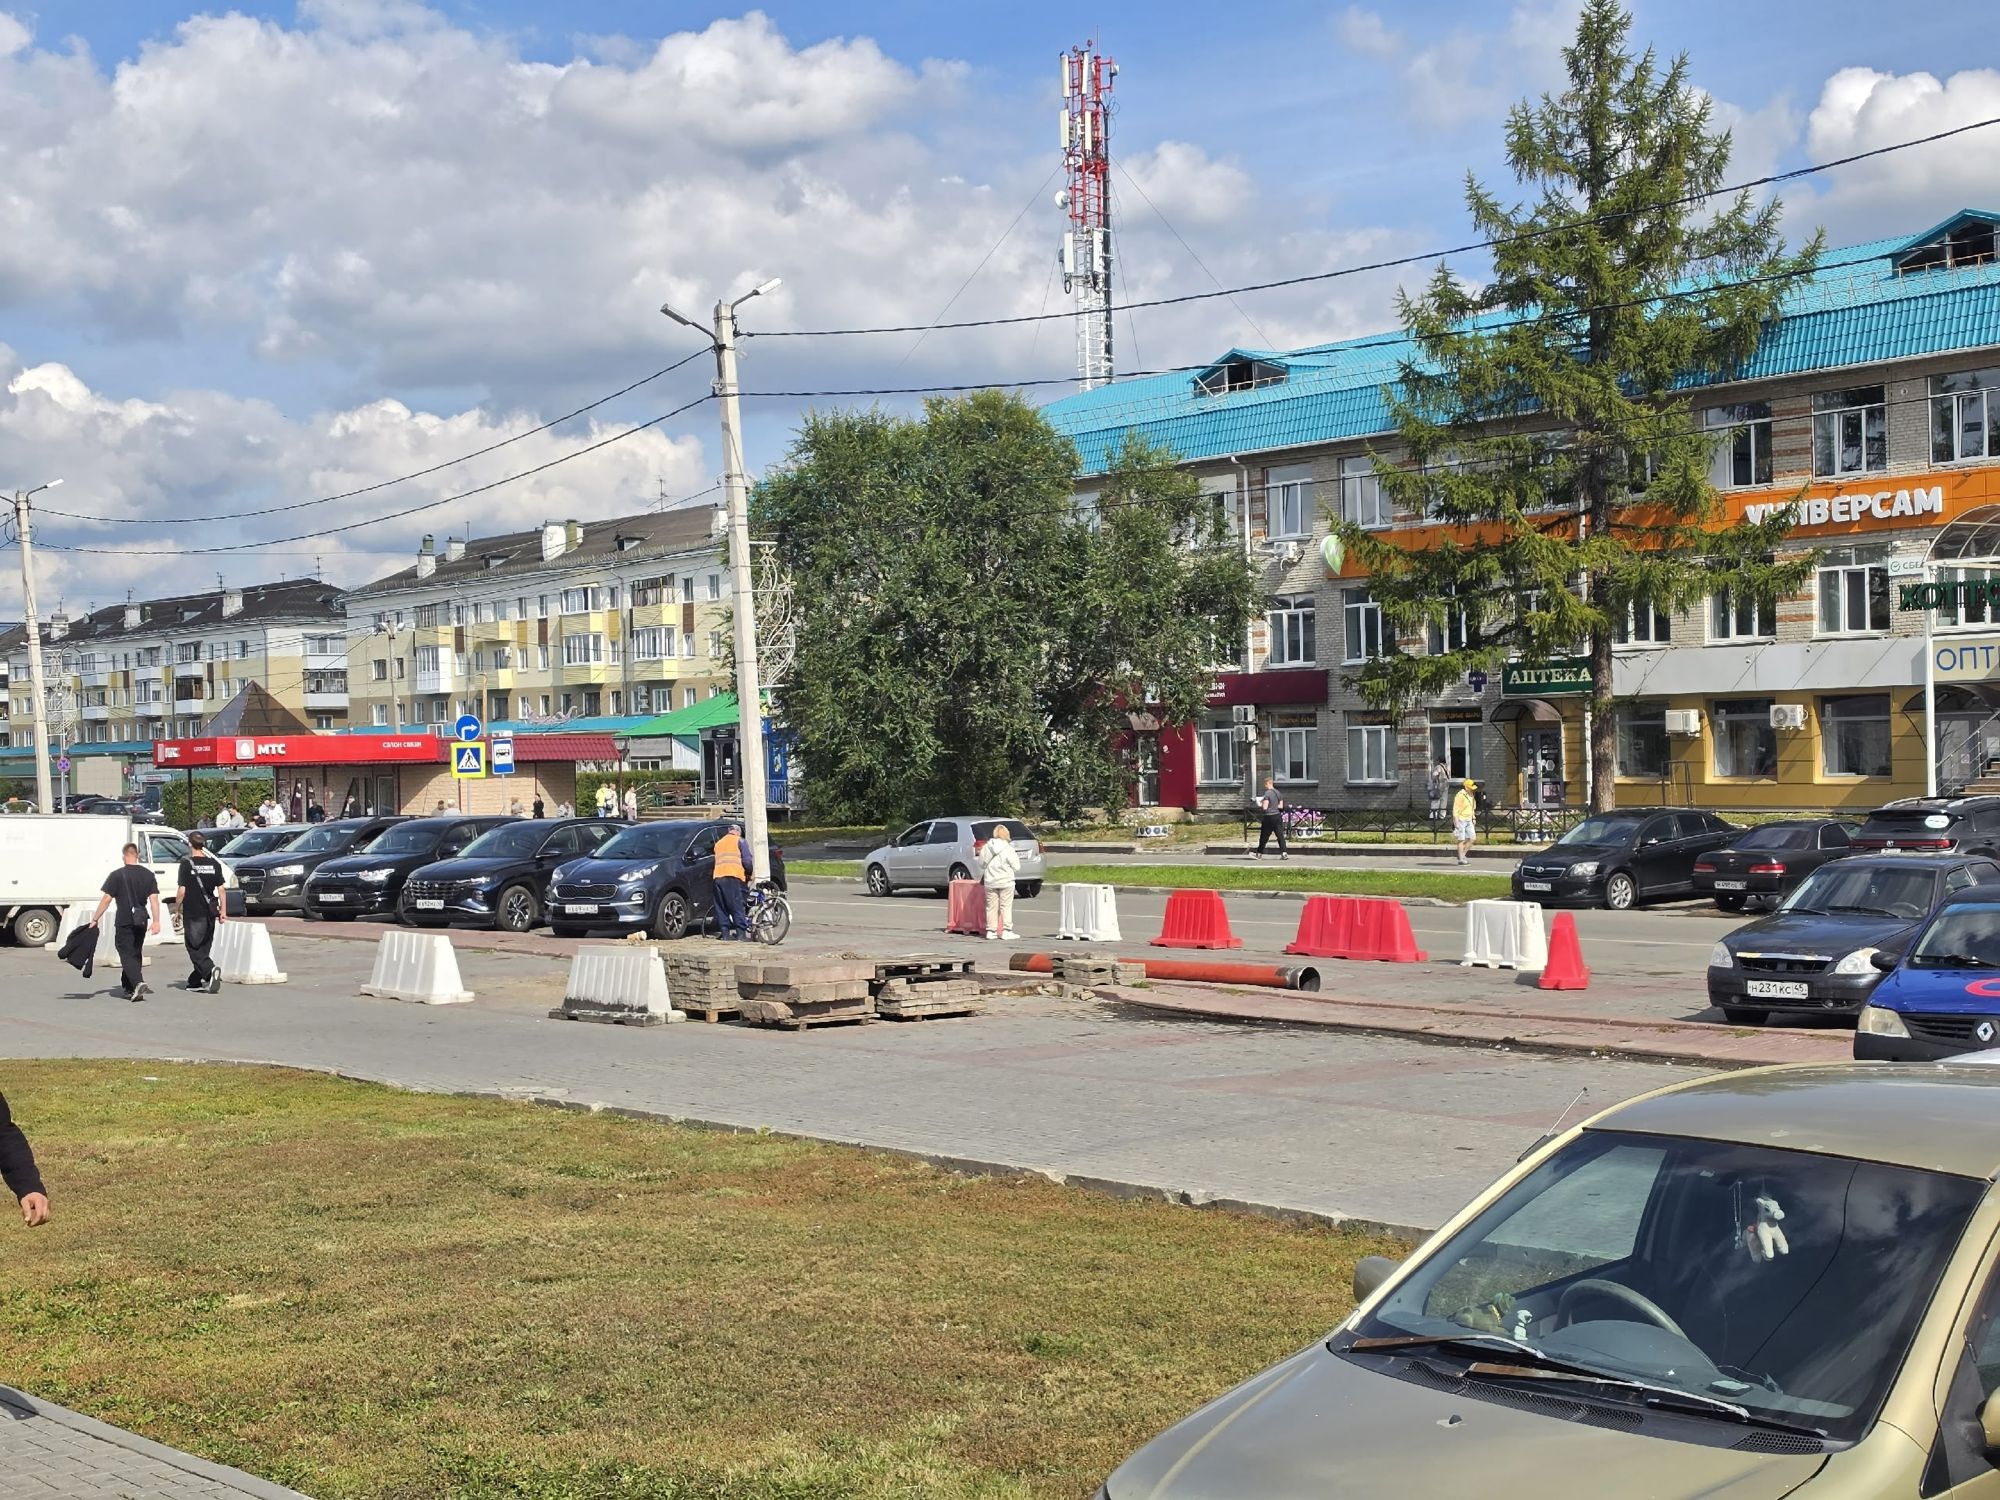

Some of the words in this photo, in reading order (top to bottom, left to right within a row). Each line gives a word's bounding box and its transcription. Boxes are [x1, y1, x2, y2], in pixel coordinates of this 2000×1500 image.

[1903, 561, 1922, 569] СБЕ
[1936, 645, 2000, 671] ОПТ
[1508, 666, 1593, 685] АПТЕКА
[257, 743, 287, 755] МТС
